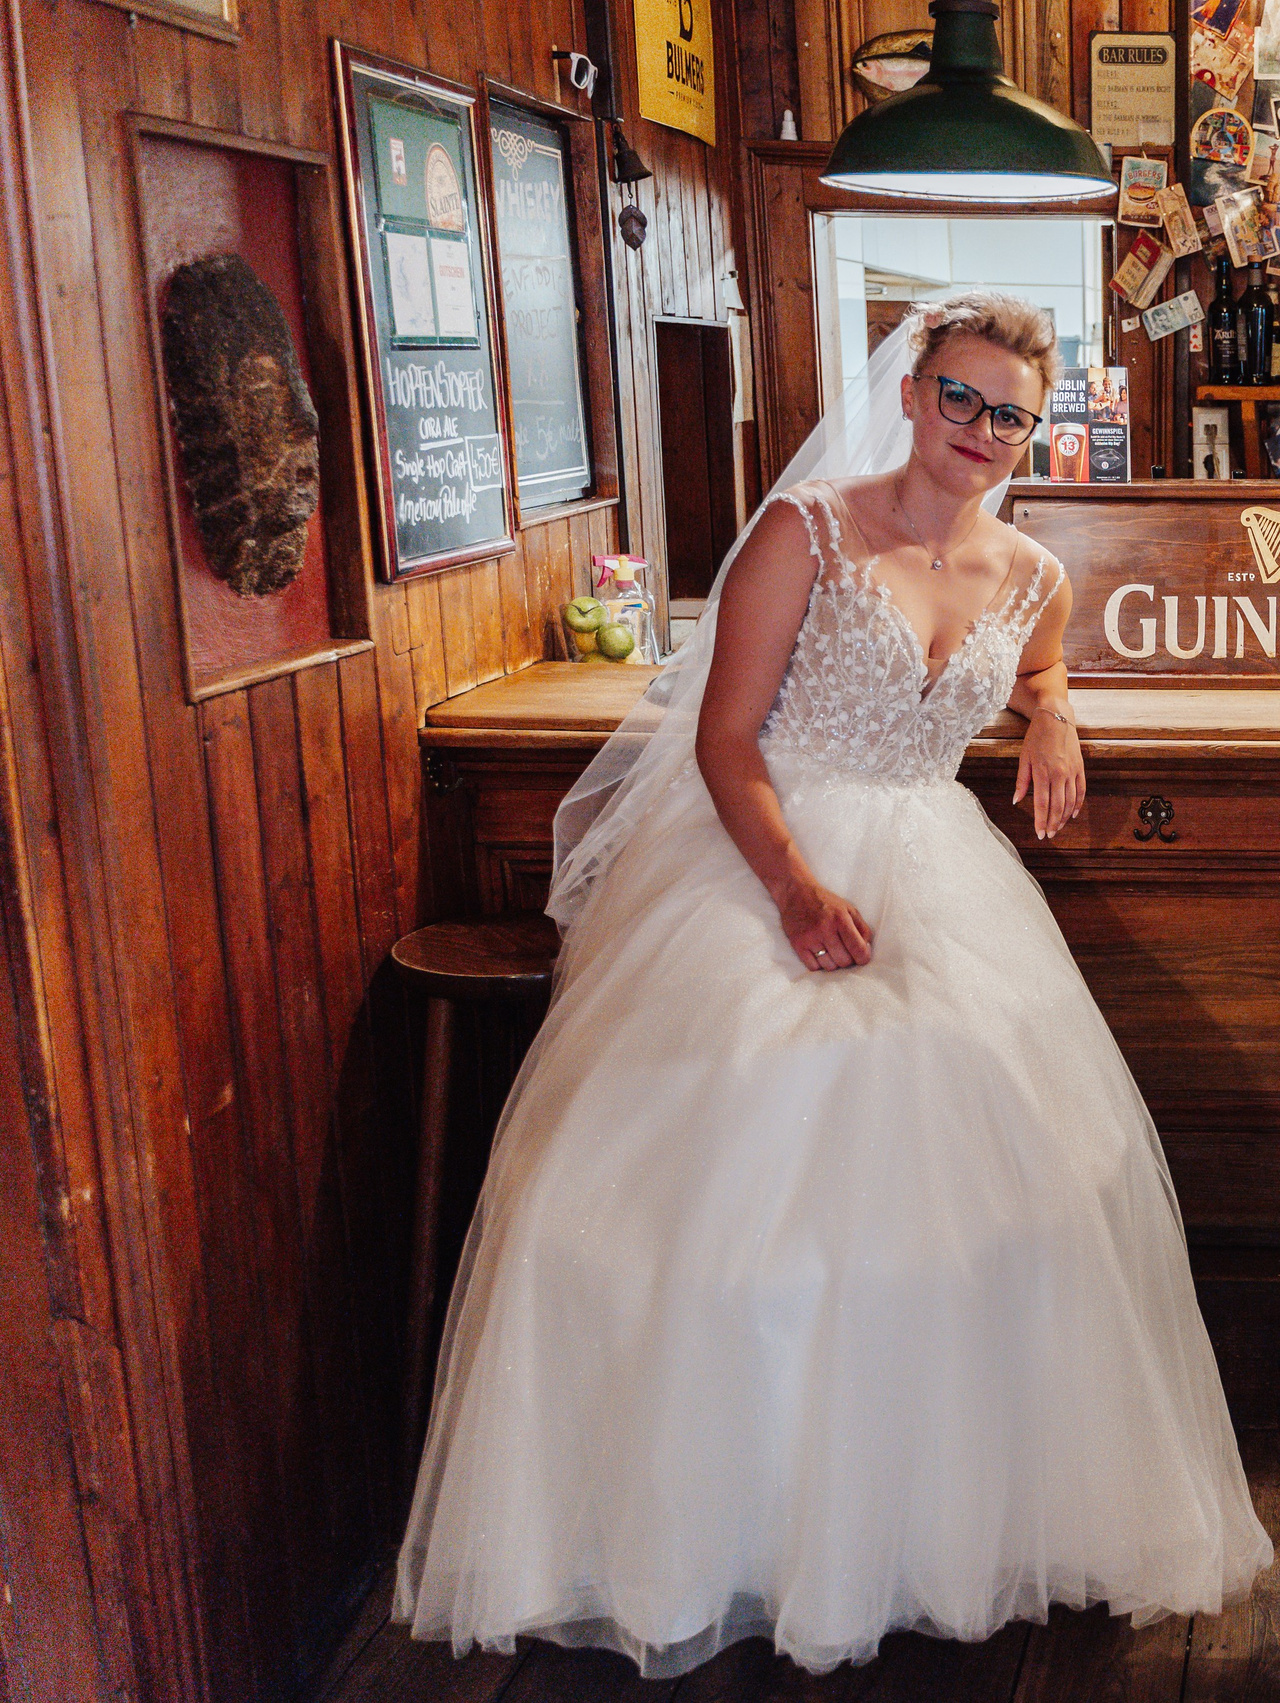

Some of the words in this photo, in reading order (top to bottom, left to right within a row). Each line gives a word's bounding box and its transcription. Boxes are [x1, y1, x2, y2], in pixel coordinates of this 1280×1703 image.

[1102, 48, 1126, 63] BAR
[1128, 49, 1163, 63] RULES
[666, 40, 704, 95] BULMERS
[1127, 169, 1162, 181] BURGERS
[1052, 391, 1077, 402] BORN
[1078, 391, 1086, 402] &
[1052, 403, 1086, 412] BREWED
[444, 415, 459, 438] ALE
[1062, 441, 1076, 450] 13
[395, 450, 425, 484] Single
[427, 454, 445, 484] Hop
